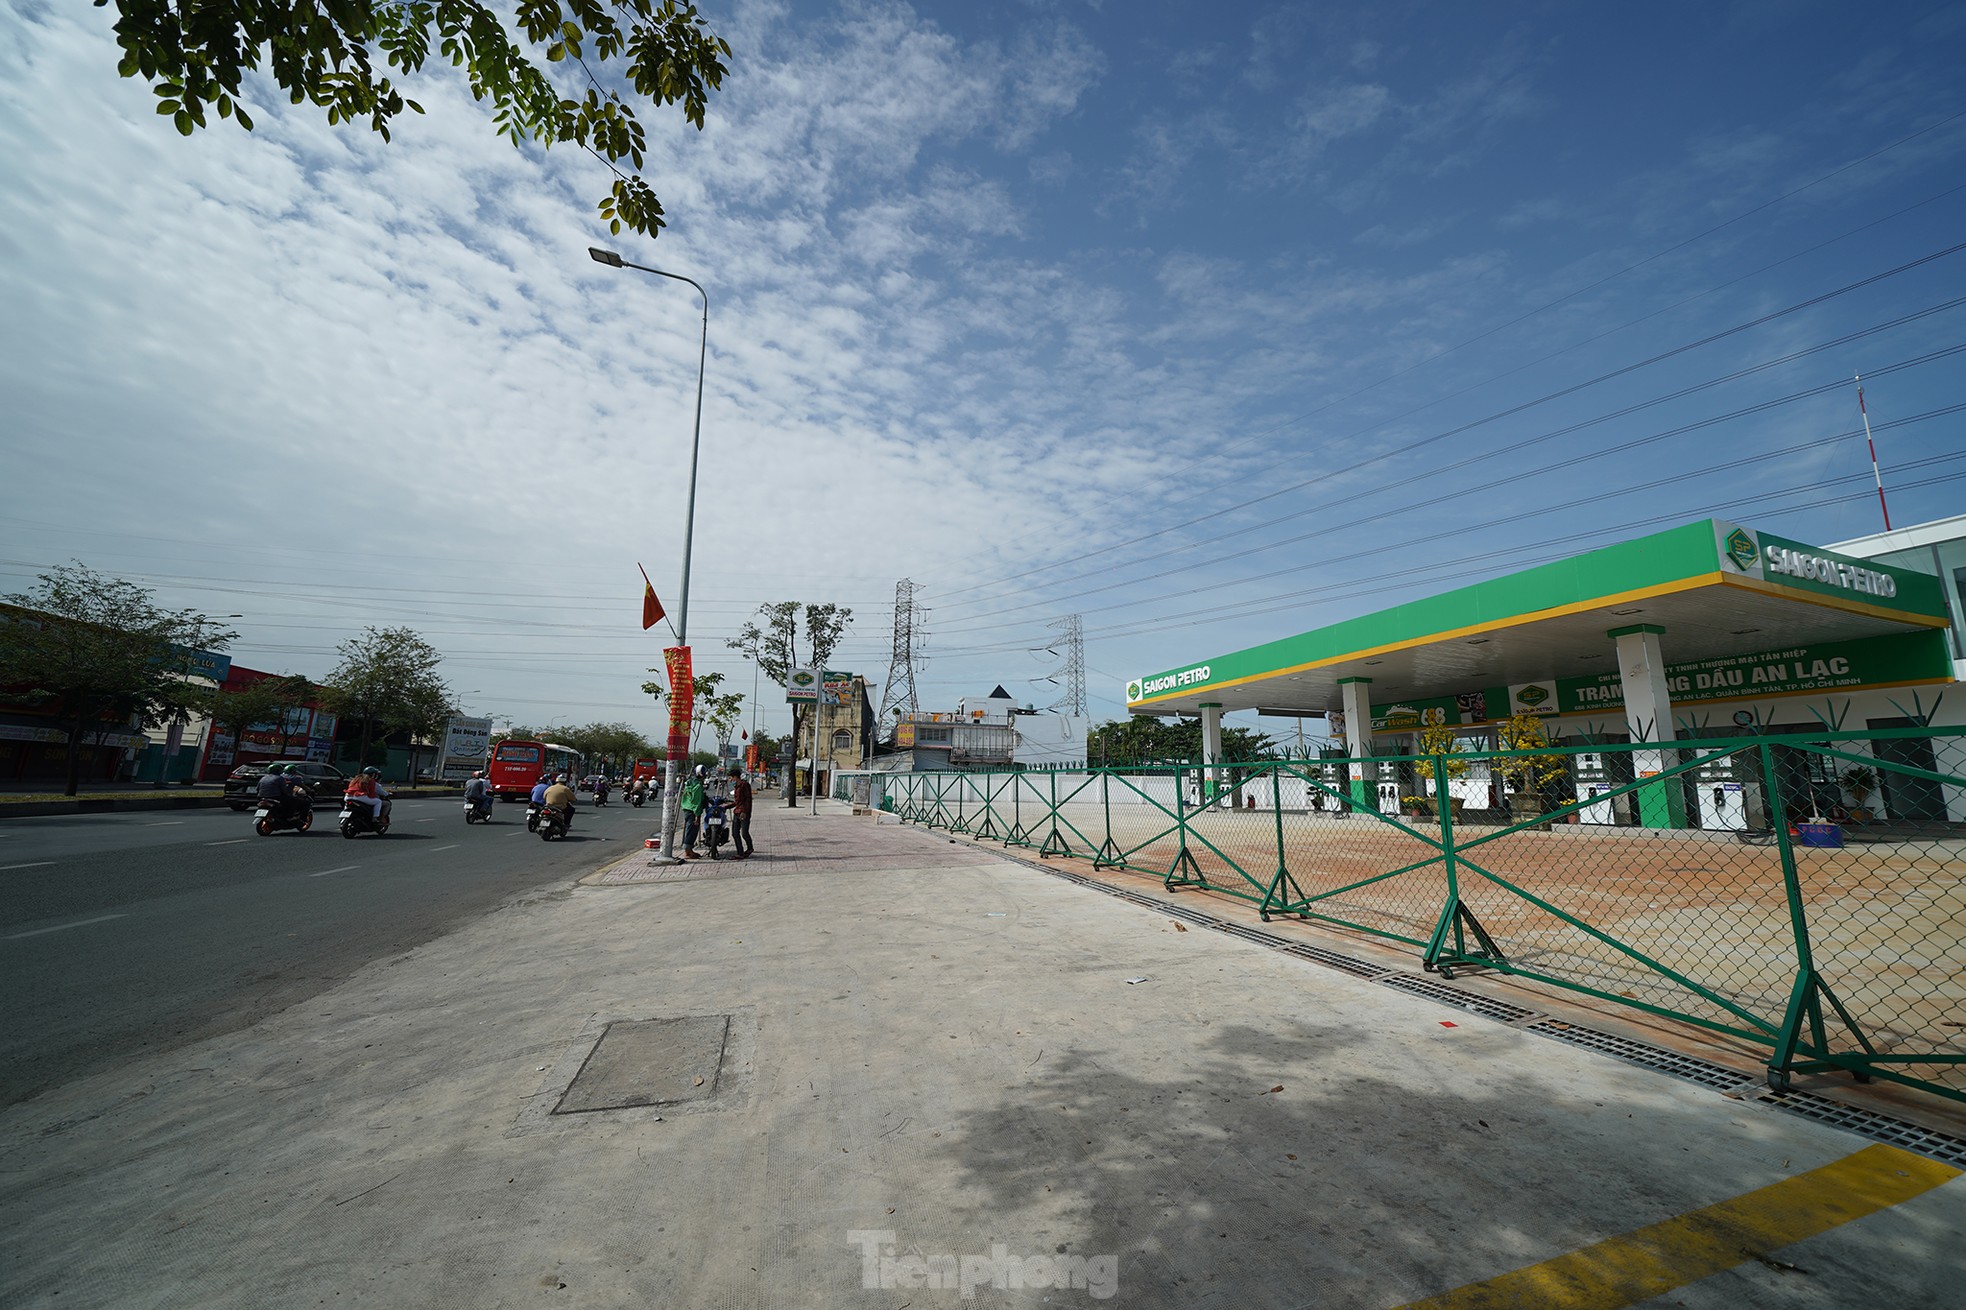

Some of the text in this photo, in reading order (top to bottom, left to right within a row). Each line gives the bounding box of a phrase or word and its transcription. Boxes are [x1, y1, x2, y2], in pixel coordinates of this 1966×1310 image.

[1766, 545, 1897, 598] SAIGON PETRO
[1143, 665, 1211, 694] SAIGON PETRO
[1695, 666, 1744, 689] DẦU
[1751, 664, 1788, 684] AN
[1794, 657, 1850, 680] LẠC
[1836, 677, 1861, 686] MINH
[1371, 720, 1388, 728] Car
